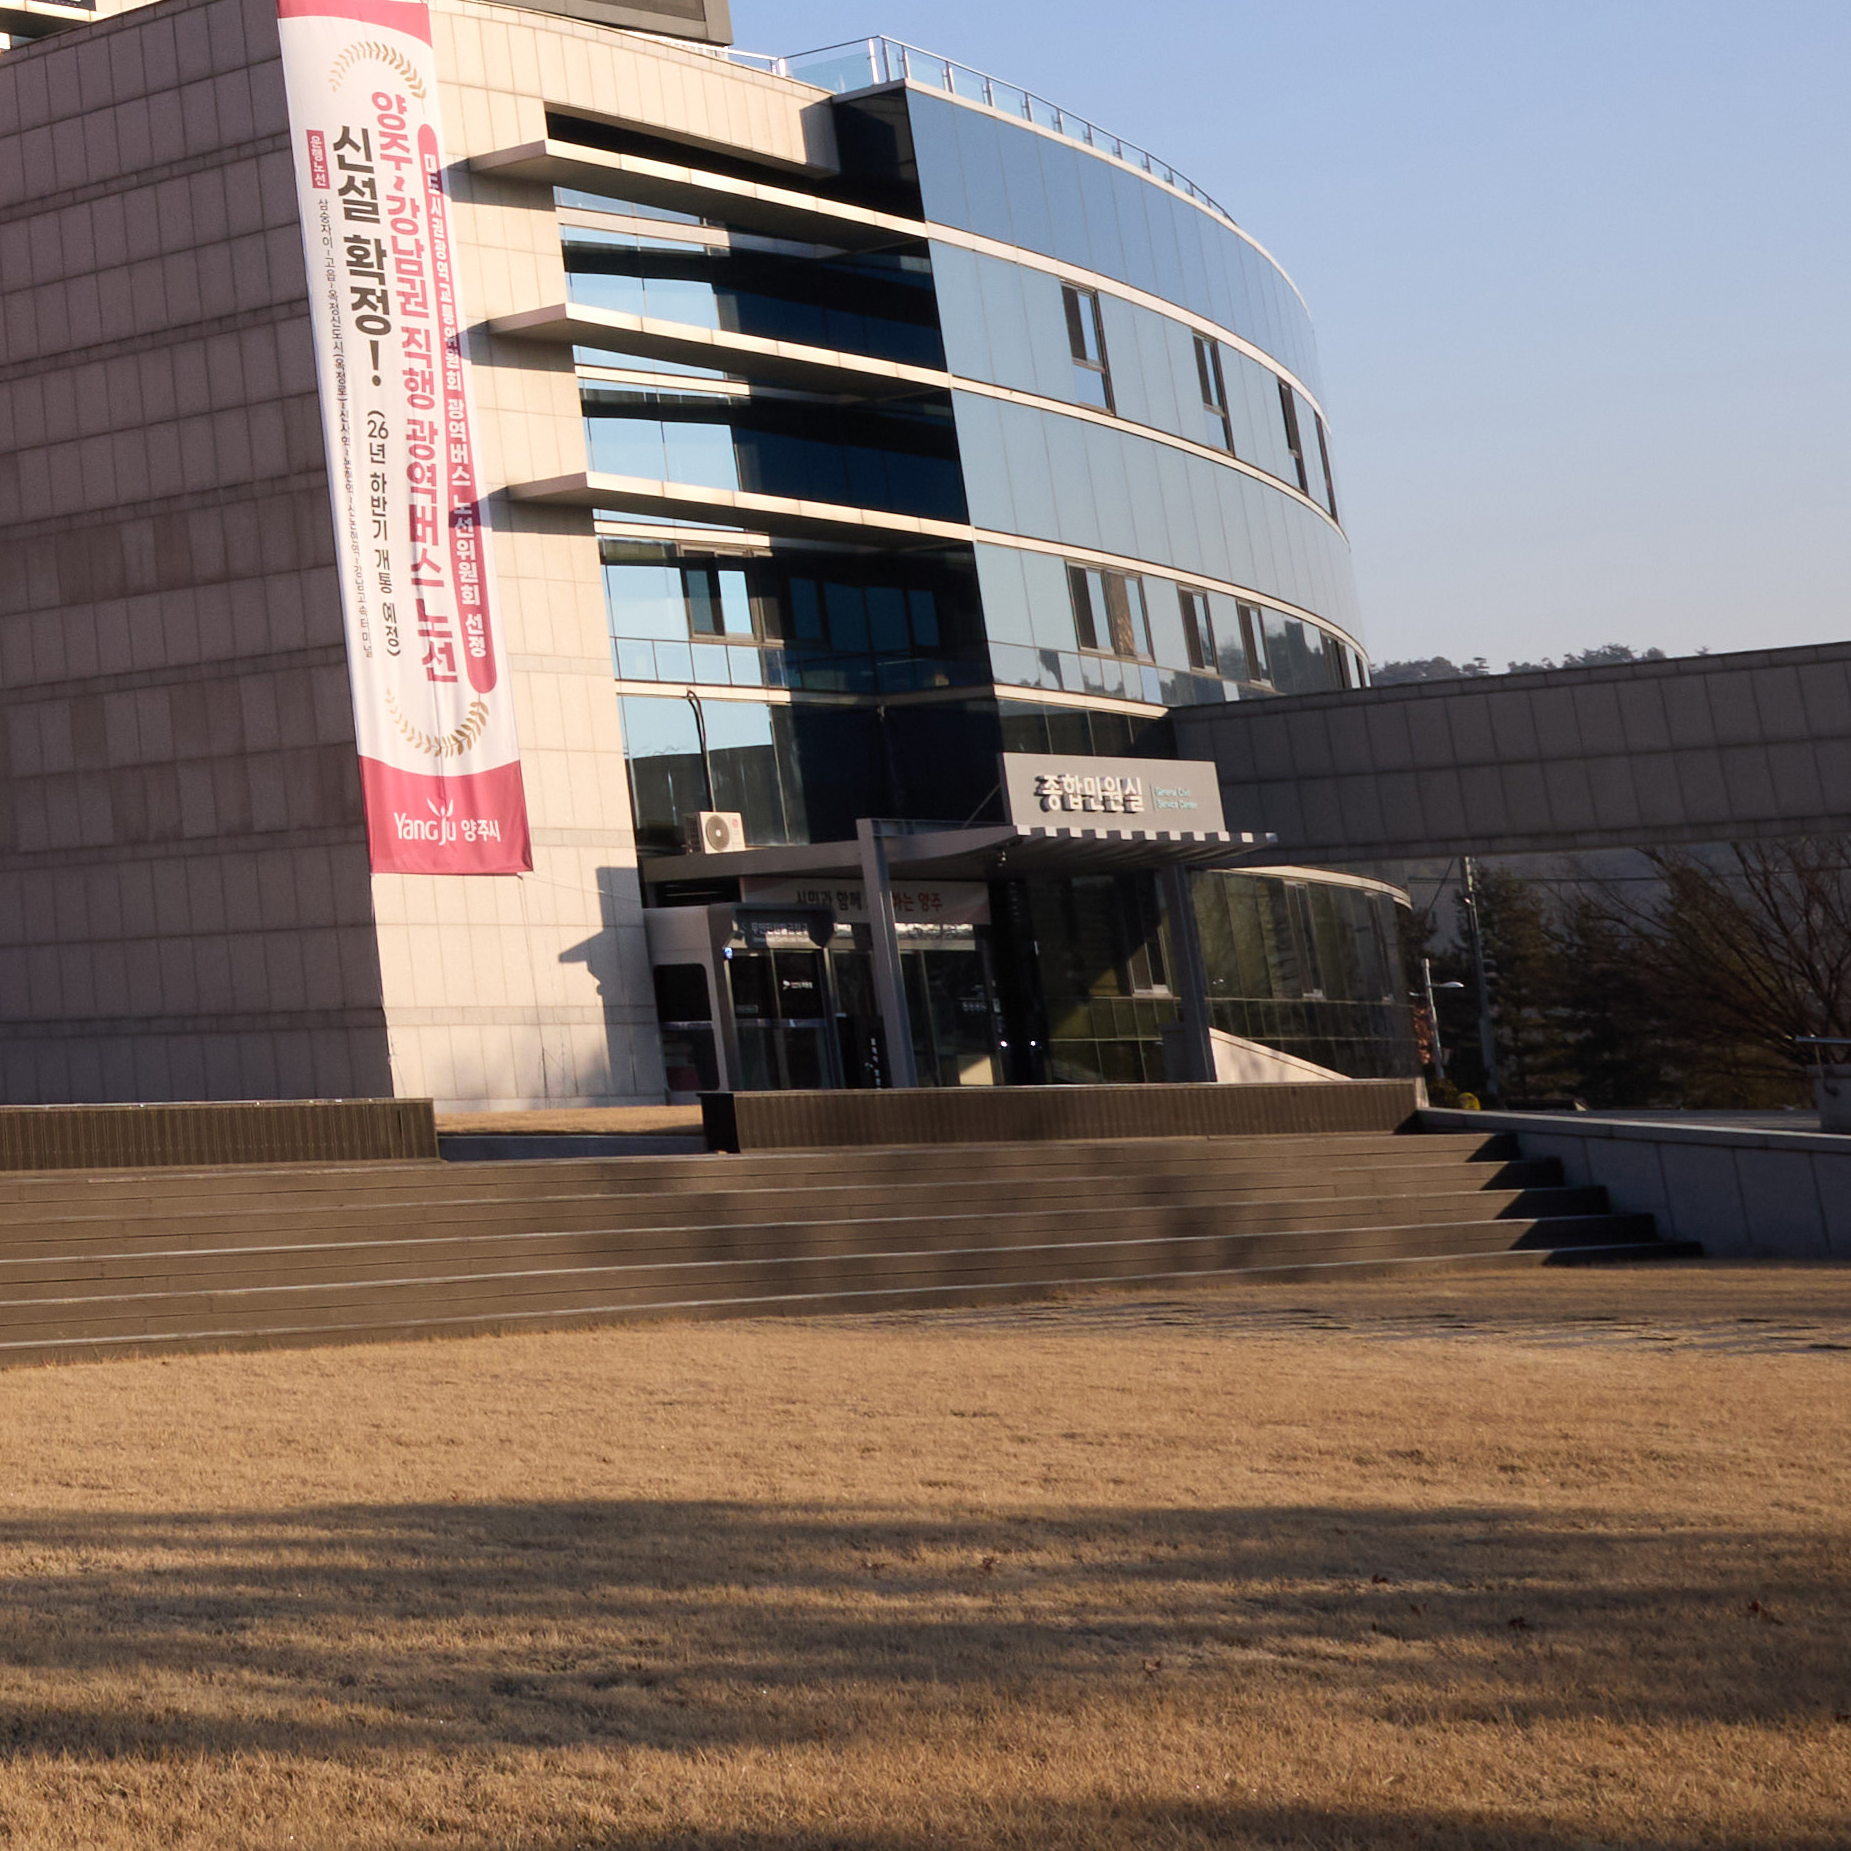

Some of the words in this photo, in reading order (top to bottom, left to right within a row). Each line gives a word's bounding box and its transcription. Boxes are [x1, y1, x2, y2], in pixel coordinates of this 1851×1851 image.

[333, 125, 381, 224] 신설
[343, 234, 392, 387] 확정!
[400, 326, 436, 411] 직행
[448, 399, 472, 487] 광역버스
[370, 472, 389, 541] 하반기
[406, 418, 445, 588] 광역버스
[376, 549, 393, 595] 개통
[453, 494, 481, 606] 노선위원회
[382, 602, 401, 657] 예정)
[416, 598, 459, 683] 노선
[465, 613, 487, 658] 선정
[461, 818, 501, 842] 양주시
[1037, 773, 1145, 813] 종합민원실
